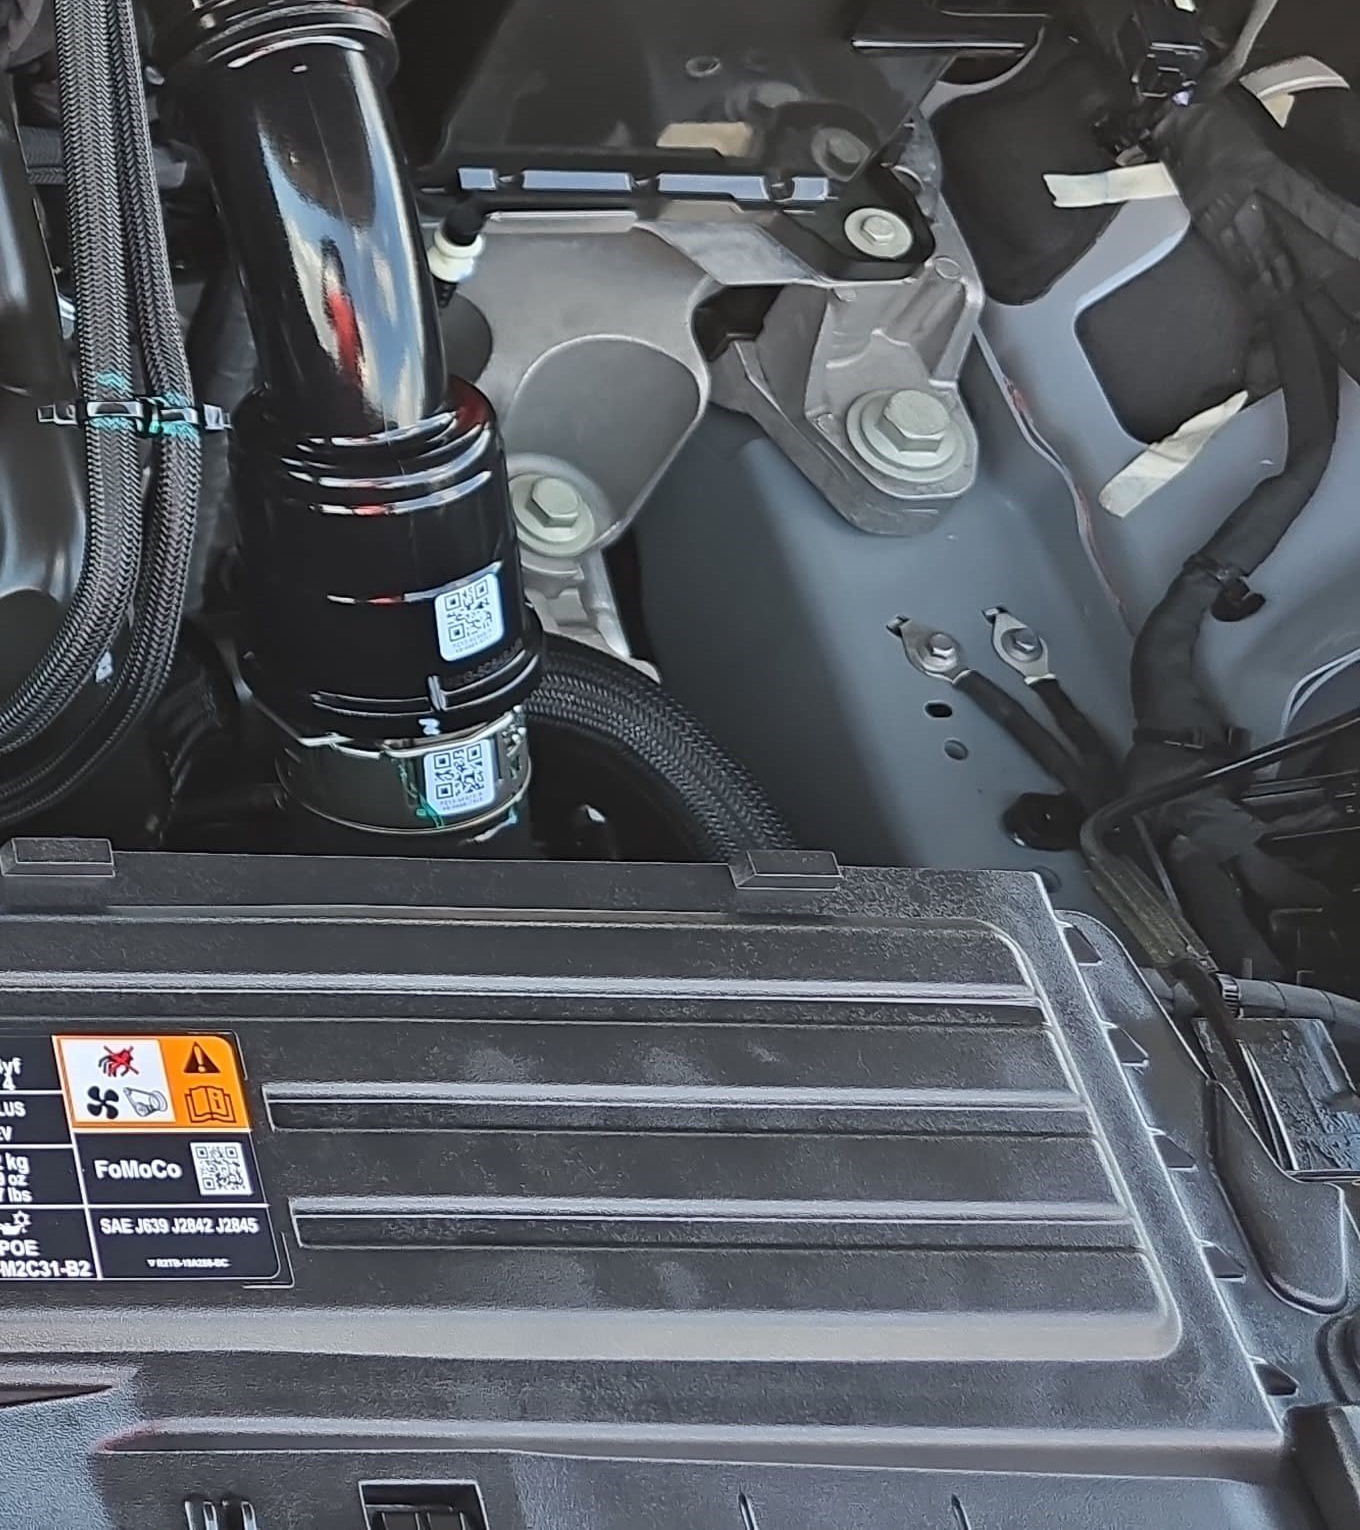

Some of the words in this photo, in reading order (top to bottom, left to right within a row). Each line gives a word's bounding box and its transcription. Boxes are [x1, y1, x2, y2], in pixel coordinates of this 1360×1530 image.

[3, 1074, 17, 1091] 4
[0, 1153, 29, 1174] kg
[95, 1160, 181, 1178] FoMoCo
[8, 1173, 28, 1186] oz
[8, 1187, 32, 1202] lbs
[100, 1218, 133, 1234] SAE
[135, 1218, 169, 1233] J639
[172, 1218, 214, 1233] J2842
[216, 1218, 259, 1233] J2845
